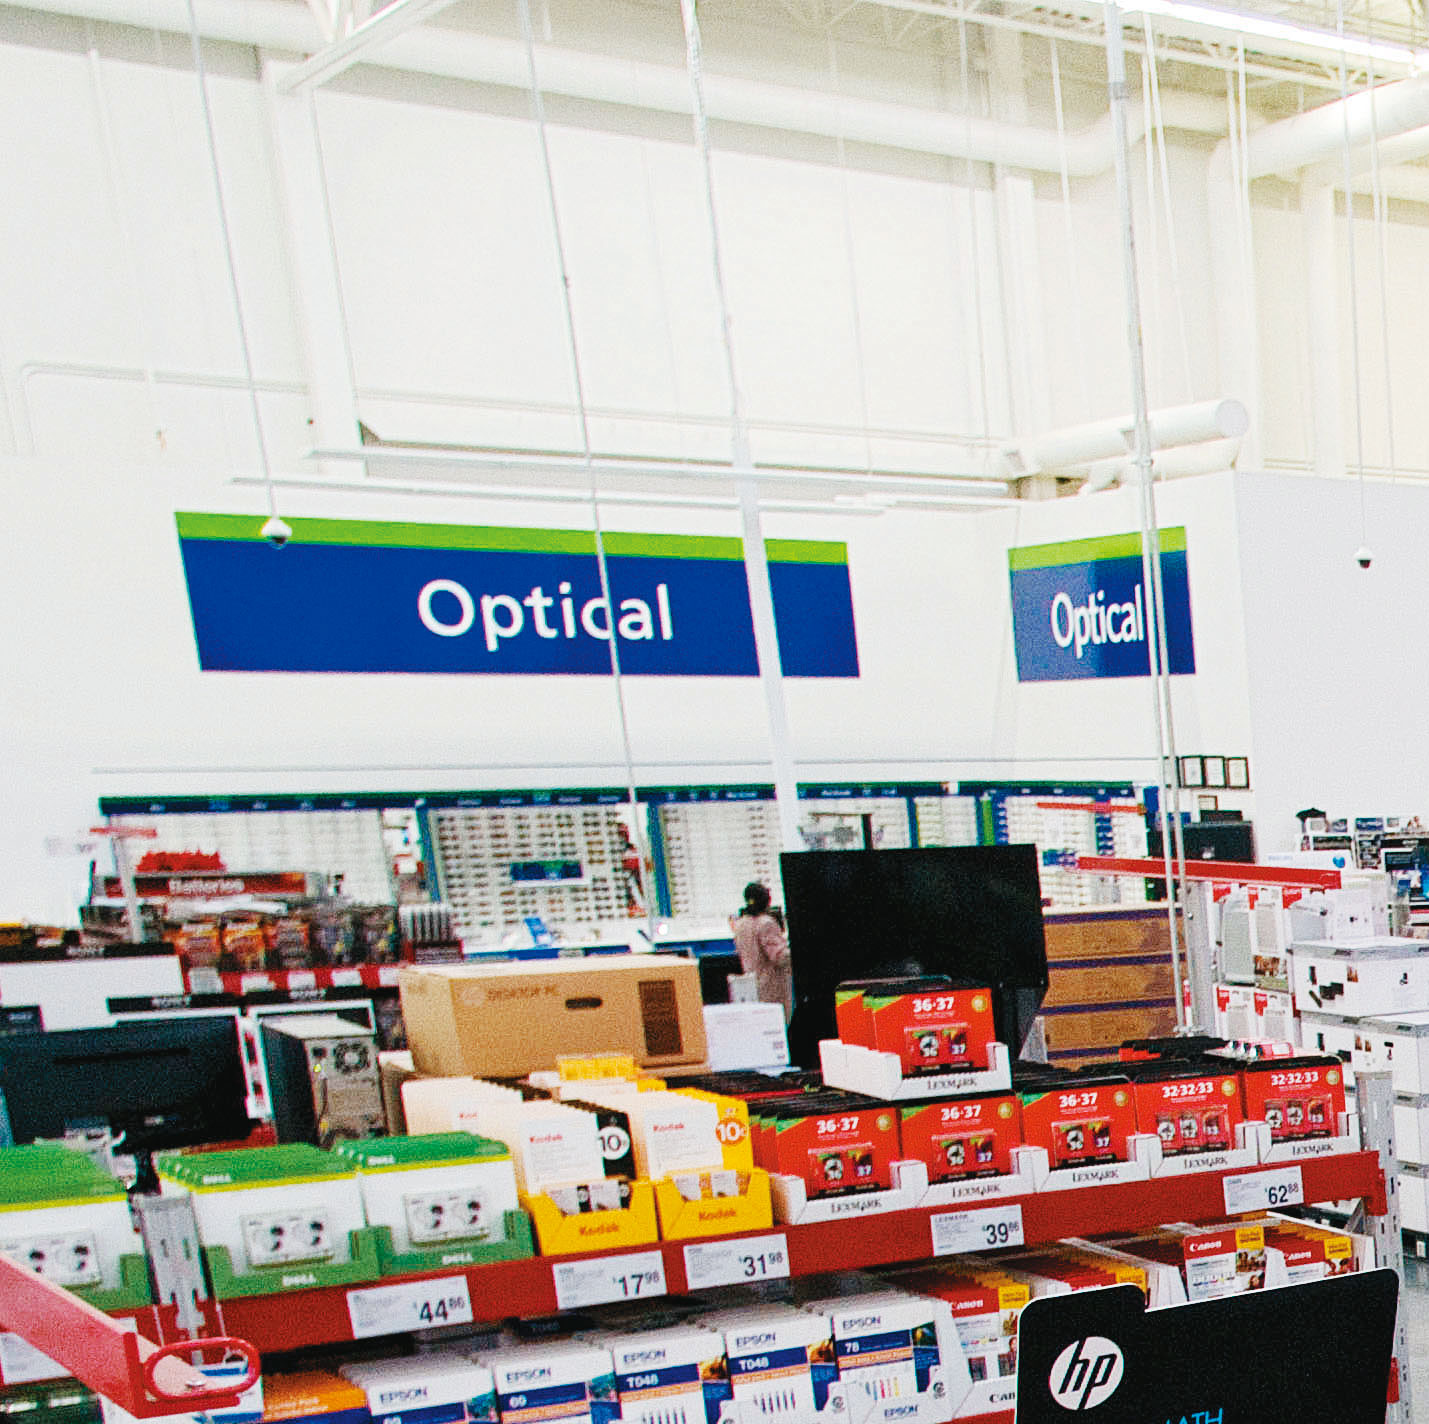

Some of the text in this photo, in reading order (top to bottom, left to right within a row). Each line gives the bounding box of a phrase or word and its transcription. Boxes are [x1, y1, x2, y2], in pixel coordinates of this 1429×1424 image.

[417, 578, 674, 651] Optical
[1050, 583, 1145, 660] Optical
[926, 1076, 978, 1090] LEXMARK
[1291, 1141, 1335, 1156] LEXMARK
[1182, 1155, 1229, 1170] LEXMARK
[1071, 1167, 1120, 1183] LEXMARK
[951, 1183, 1001, 1198] LEXMARK
[831, 1198, 883, 1214] LEXMARK
[1188, 1239, 1222, 1253] Canon
[842, 1315, 883, 1331] EPSON
[734, 1331, 777, 1348] EPSON
[844, 1341, 860, 1354] 78
[622, 1347, 667, 1365] EPSON
[739, 1356, 770, 1372] T048
[505, 1366, 552, 1385] EPSON
[626, 1373, 659, 1389] T048
[1048, 1336, 1125, 1410] hp
[379, 1385, 428, 1405] EPSON
